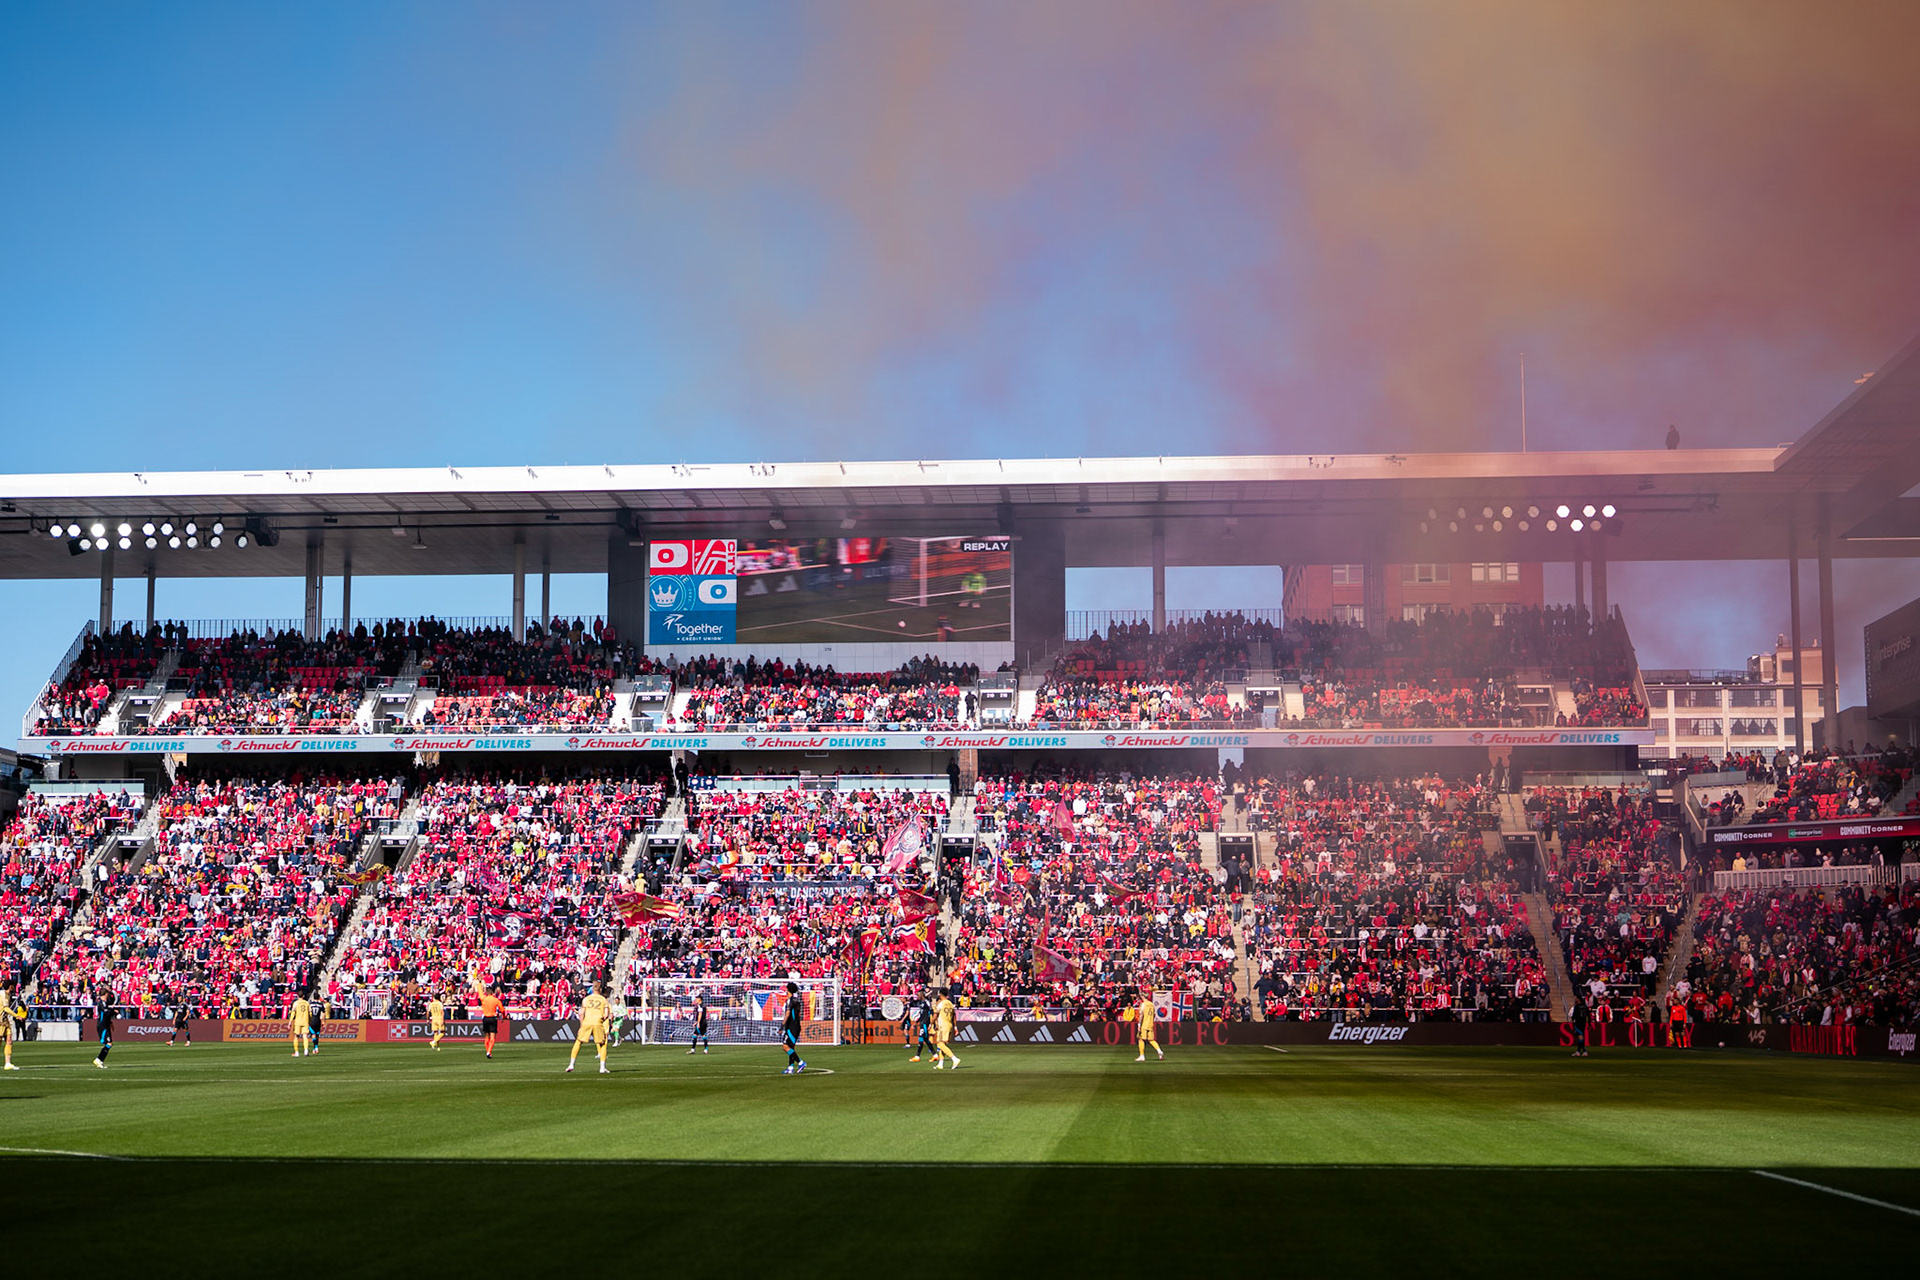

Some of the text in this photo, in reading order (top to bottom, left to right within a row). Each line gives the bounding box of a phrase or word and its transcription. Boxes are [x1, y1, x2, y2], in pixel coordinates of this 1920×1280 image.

[964, 542, 1008, 551] REPLAY
[675, 623, 723, 637] Together
[651, 738, 708, 748] DELIVERS
[829, 738, 886, 747] DELIVERS
[1008, 737, 1066, 746] DELIVERS
[1190, 736, 1248, 746] DELIVERS
[1374, 735, 1433, 744] DELIVERS
[1560, 734, 1620, 743] DELIVERS
[130, 742, 185, 750] DELIVERS
[302, 740, 357, 750] DELIVERS
[476, 740, 531, 749] DELIVERS
[1840, 826, 1871, 836] COMMUNITY
[1714, 832, 1743, 843] COMMUNITY
[588, 1000, 601, 1010] 32
[128, 1026, 174, 1035] EQUIFAX
[231, 1022, 292, 1034] DOBBS
[412, 1025, 482, 1036] PUINA
[805, 1024, 894, 1039] Coninental
[1328, 1022, 1409, 1044] Energizer
[1196, 1021, 1229, 1046] FC
[1790, 1025, 1857, 1056] CHARLOTTE FC
[1888, 1028, 1916, 1056] Energizer
